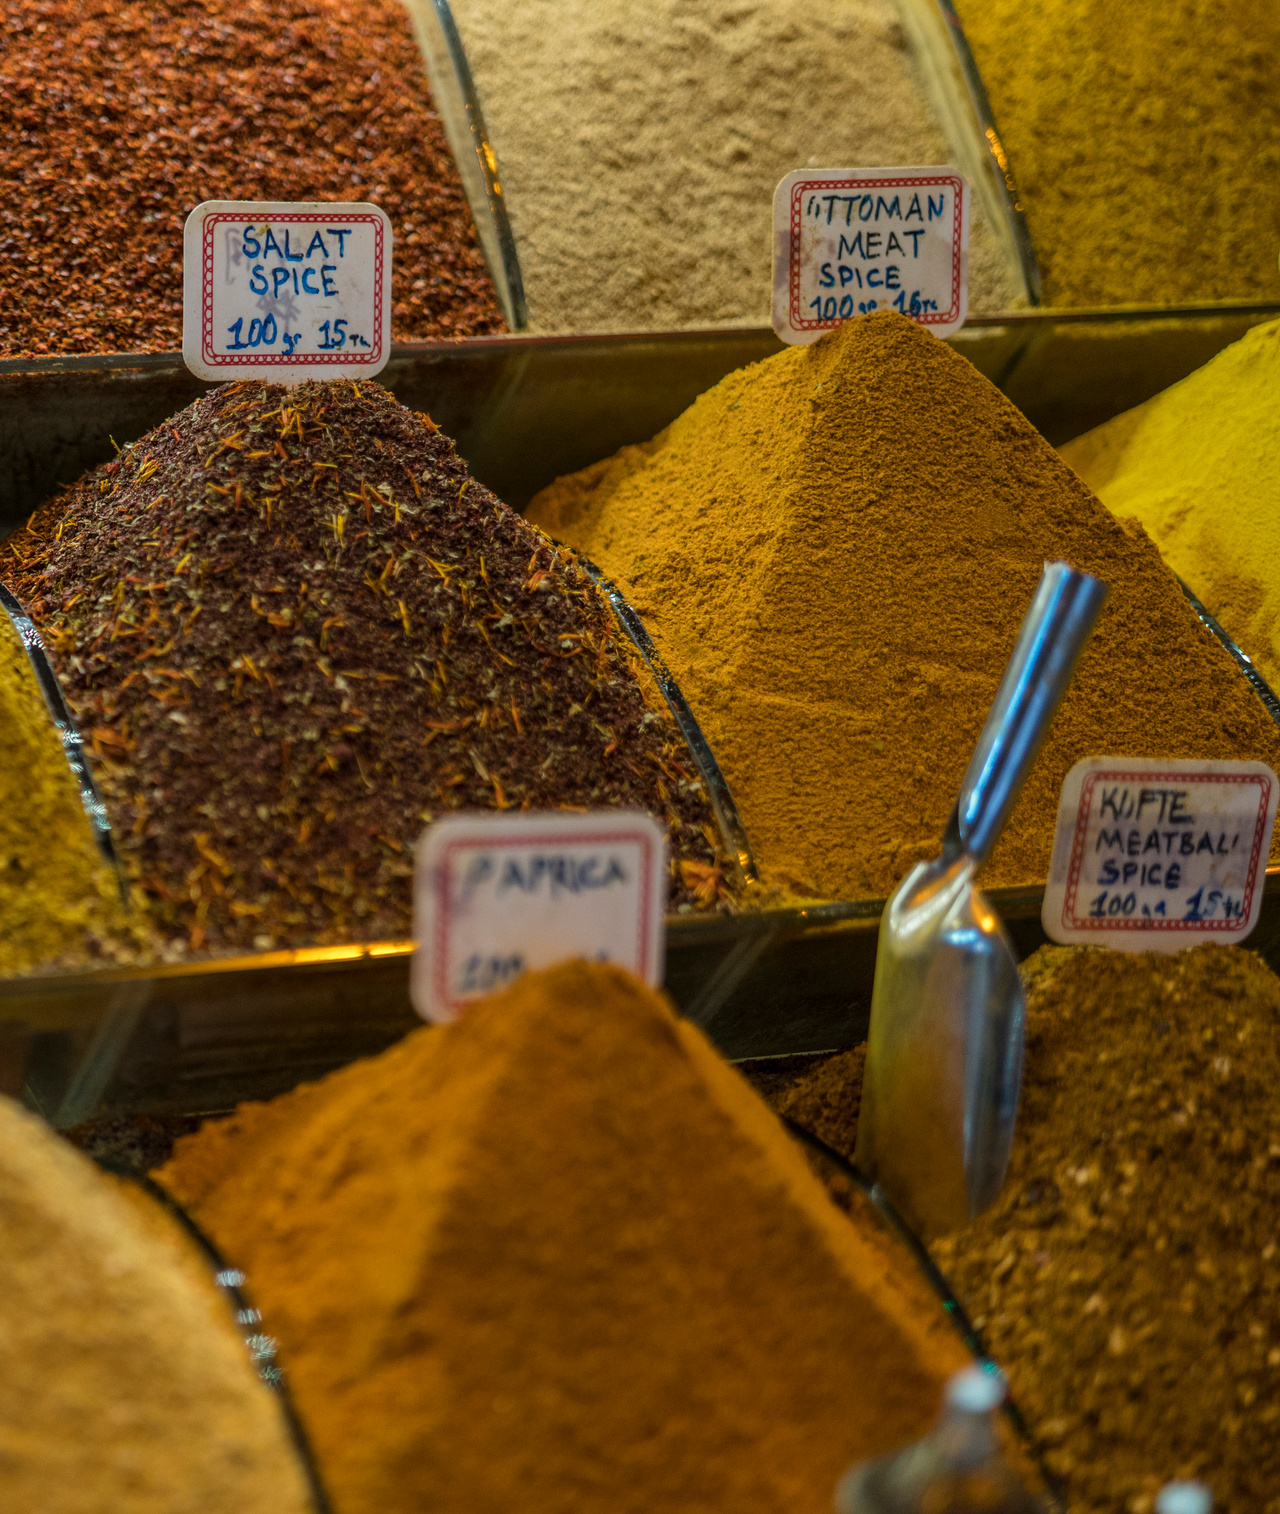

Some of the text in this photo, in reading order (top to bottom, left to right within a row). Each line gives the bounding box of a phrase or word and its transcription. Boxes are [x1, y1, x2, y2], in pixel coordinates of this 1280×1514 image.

[242, 225, 352, 262] SALAT
[837, 229, 925, 260] MEAT
[249, 264, 339, 299] SPICE
[819, 262, 901, 290] SPICE
[809, 294, 855, 323] 100
[461, 855, 626, 901] PAPRICA
[1097, 858, 1181, 889] SPICE
[1089, 890, 1136, 917] 100
